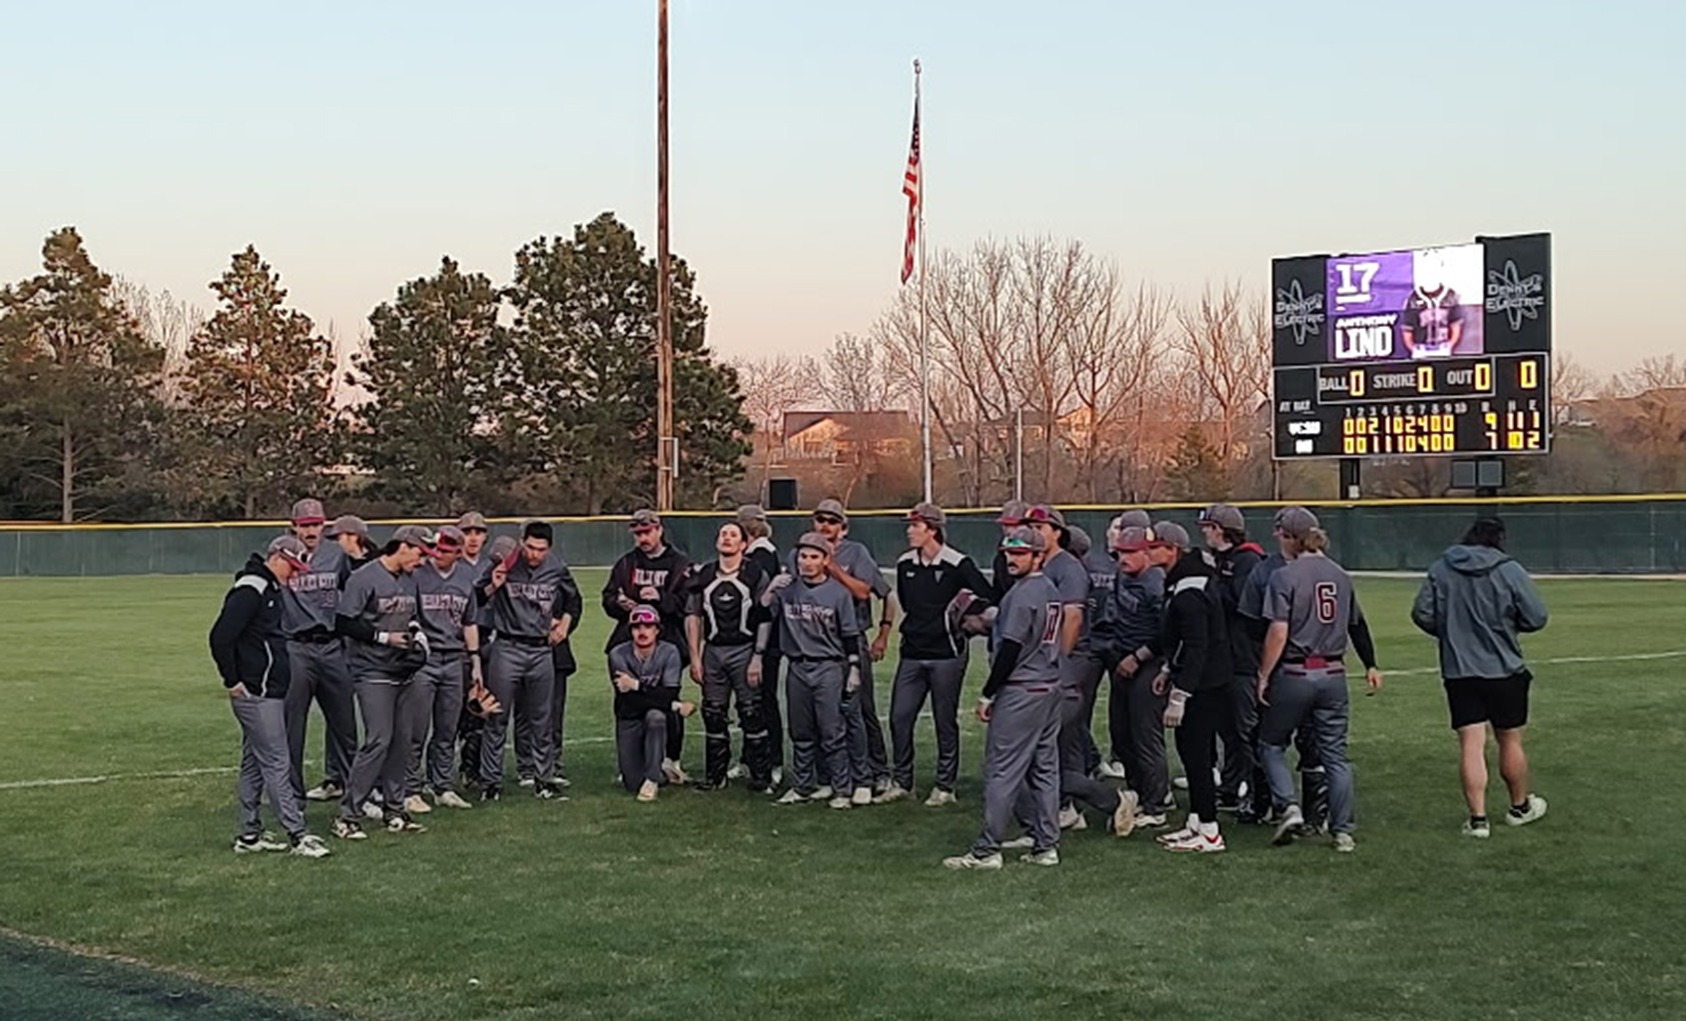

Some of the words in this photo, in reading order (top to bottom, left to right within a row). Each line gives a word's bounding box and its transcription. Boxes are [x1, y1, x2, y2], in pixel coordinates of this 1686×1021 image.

[1335, 262, 1380, 294] 17
[1320, 376, 1348, 391] BALL
[1350, 370, 1365, 396] 0
[1373, 373, 1416, 389] STRIKE
[1418, 366, 1433, 392] 0
[1447, 370, 1473, 384] OUT
[1475, 363, 1490, 390] 0
[1521, 361, 1536, 388] 0
[1485, 412, 1497, 430] 9
[1485, 431, 1497, 450] 7
[1526, 430, 1540, 449] 2
[1316, 582, 1337, 624] 6
